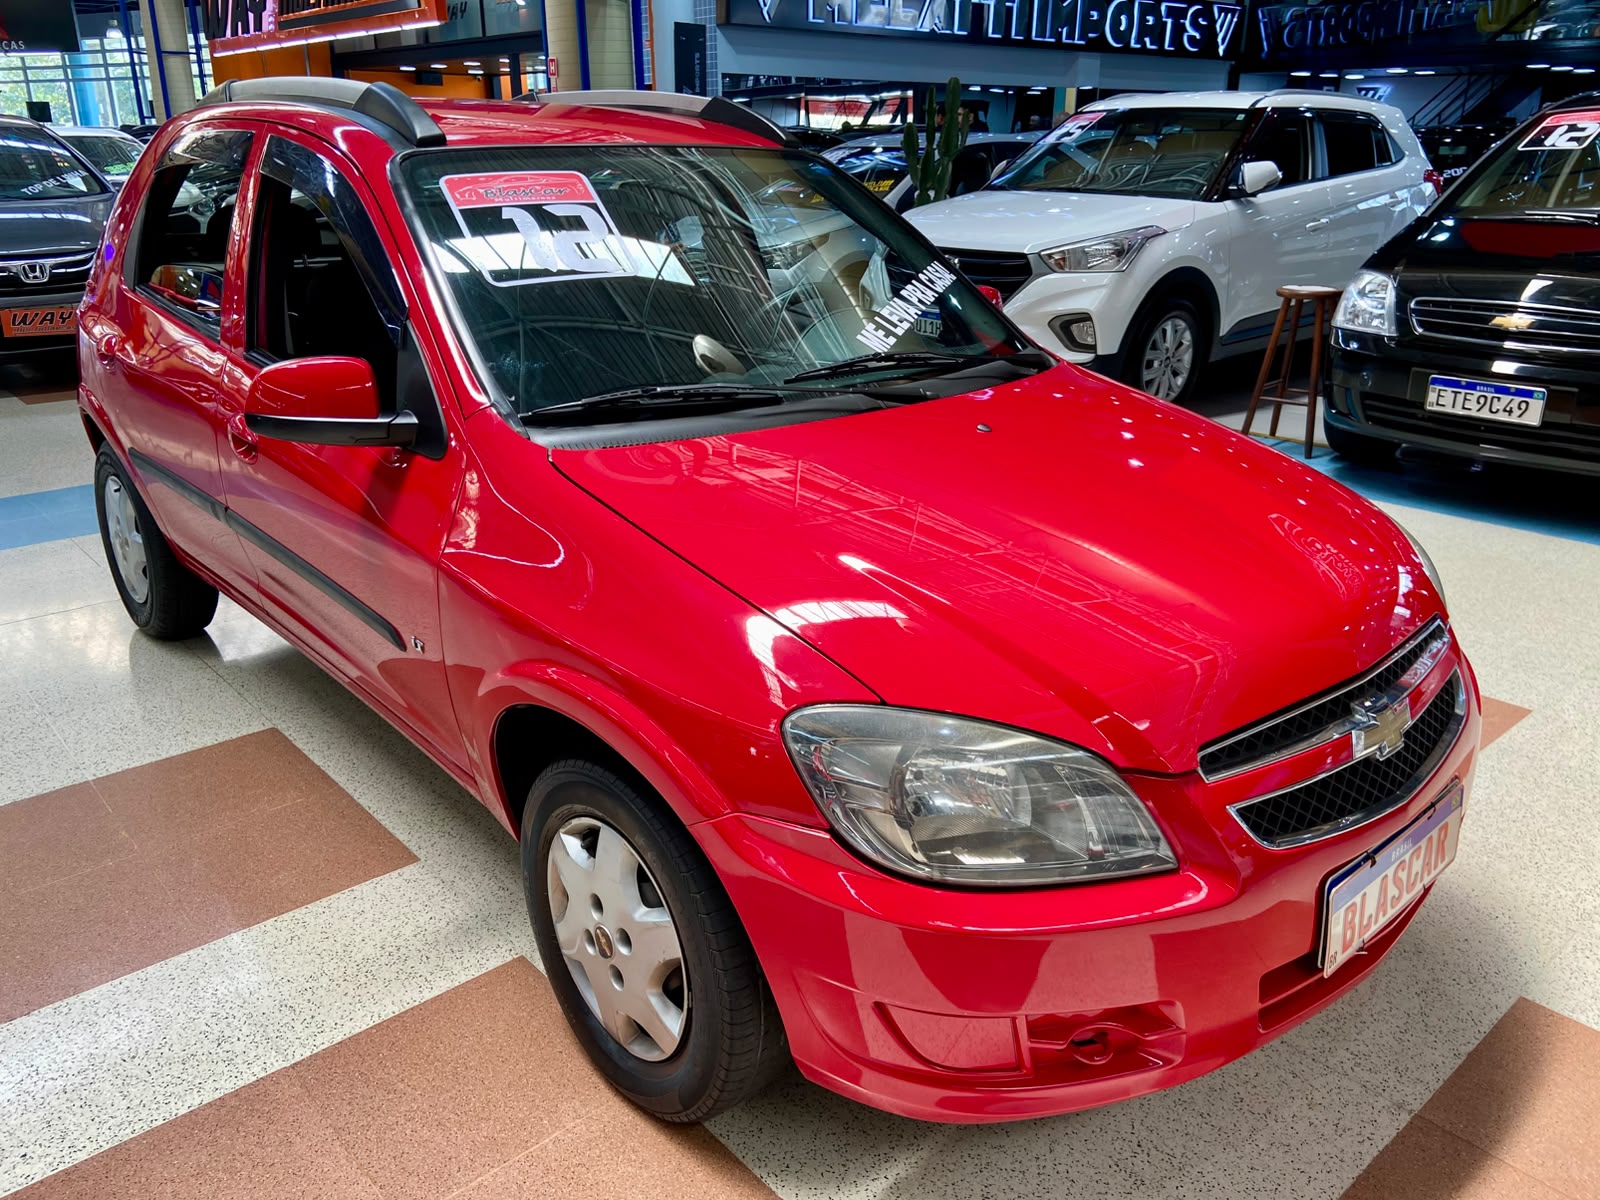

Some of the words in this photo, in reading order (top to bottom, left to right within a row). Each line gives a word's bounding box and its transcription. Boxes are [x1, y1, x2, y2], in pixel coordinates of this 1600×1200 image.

[1544, 122, 1600, 147] 12
[21, 183, 43, 195] TOP
[42, 178, 60, 188] DE
[900, 279, 939, 310] PRA
[11, 311, 74, 328] WAY
[874, 297, 922, 336] LEVA
[856, 322, 897, 355] ME
[1435, 388, 1530, 418] ETE9C49
[1391, 838, 1413, 862] BRASIL
[1341, 821, 1449, 953] BLASCAR
